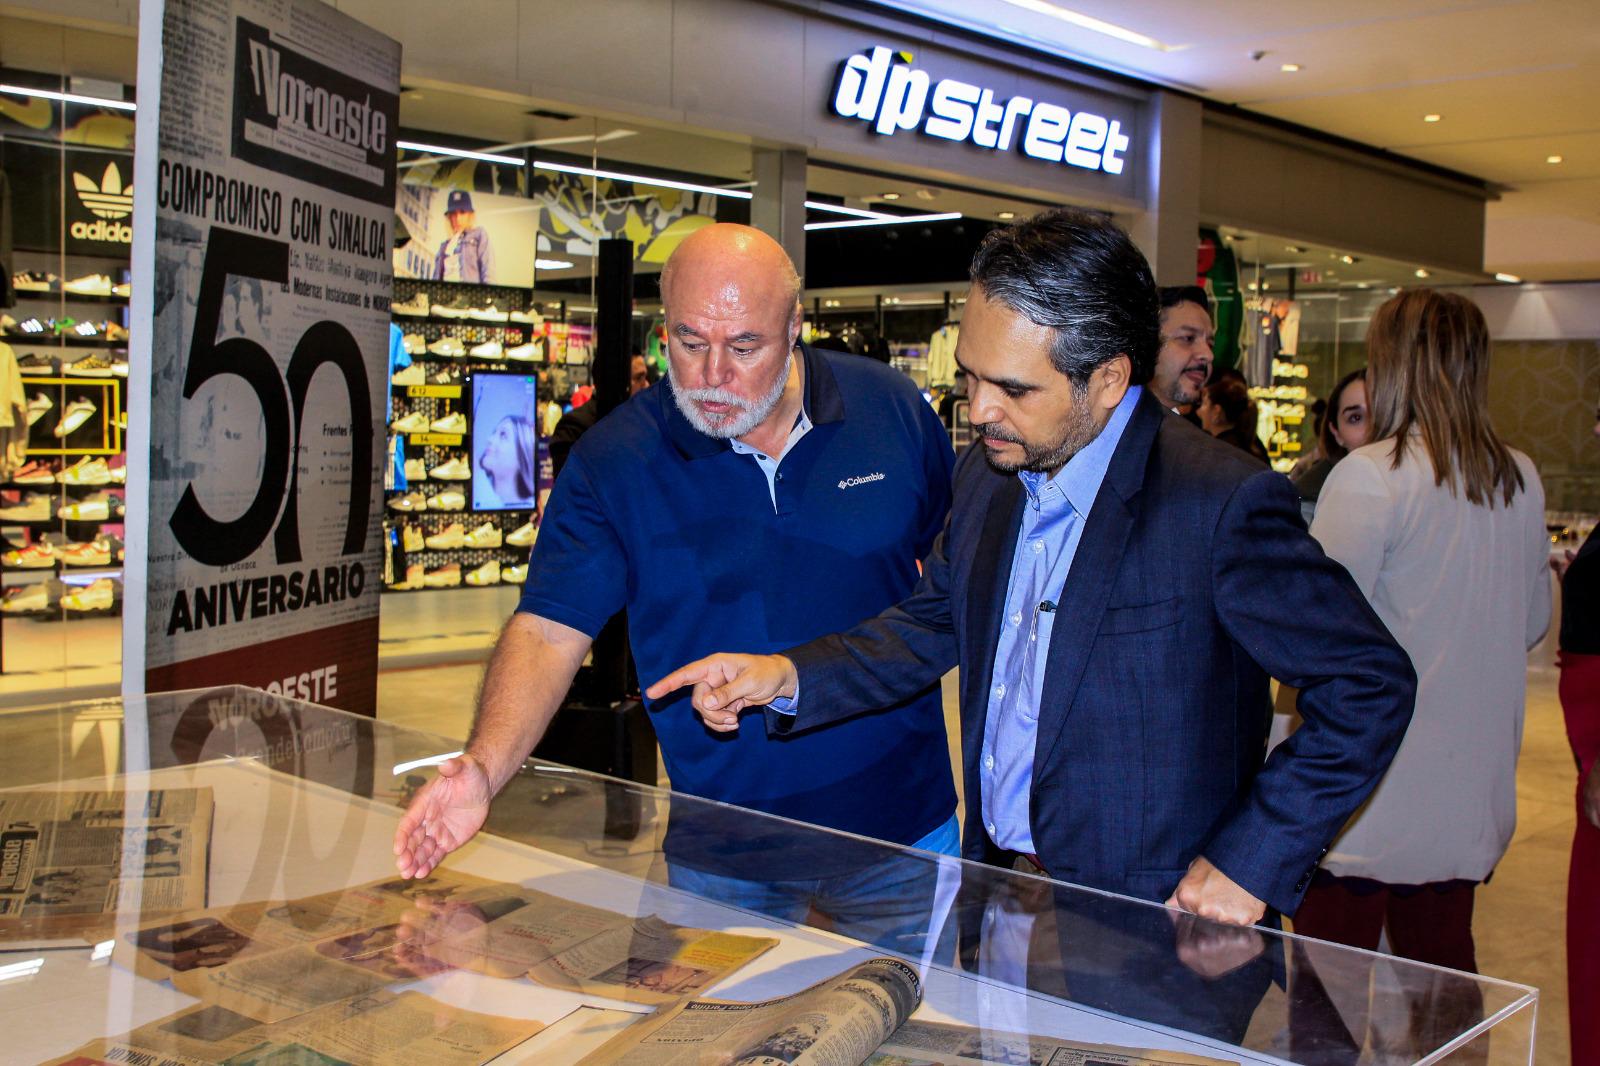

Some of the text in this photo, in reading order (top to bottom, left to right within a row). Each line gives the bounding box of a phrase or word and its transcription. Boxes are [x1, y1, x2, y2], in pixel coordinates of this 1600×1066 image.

[248, 37, 387, 155] Noroeste
[71, 220, 132, 243] adida
[157, 159, 387, 261] COMPROMISO CON SINALOA
[847, 472, 885, 487] Columbia
[167, 562, 365, 636] ANIVERSARIO
